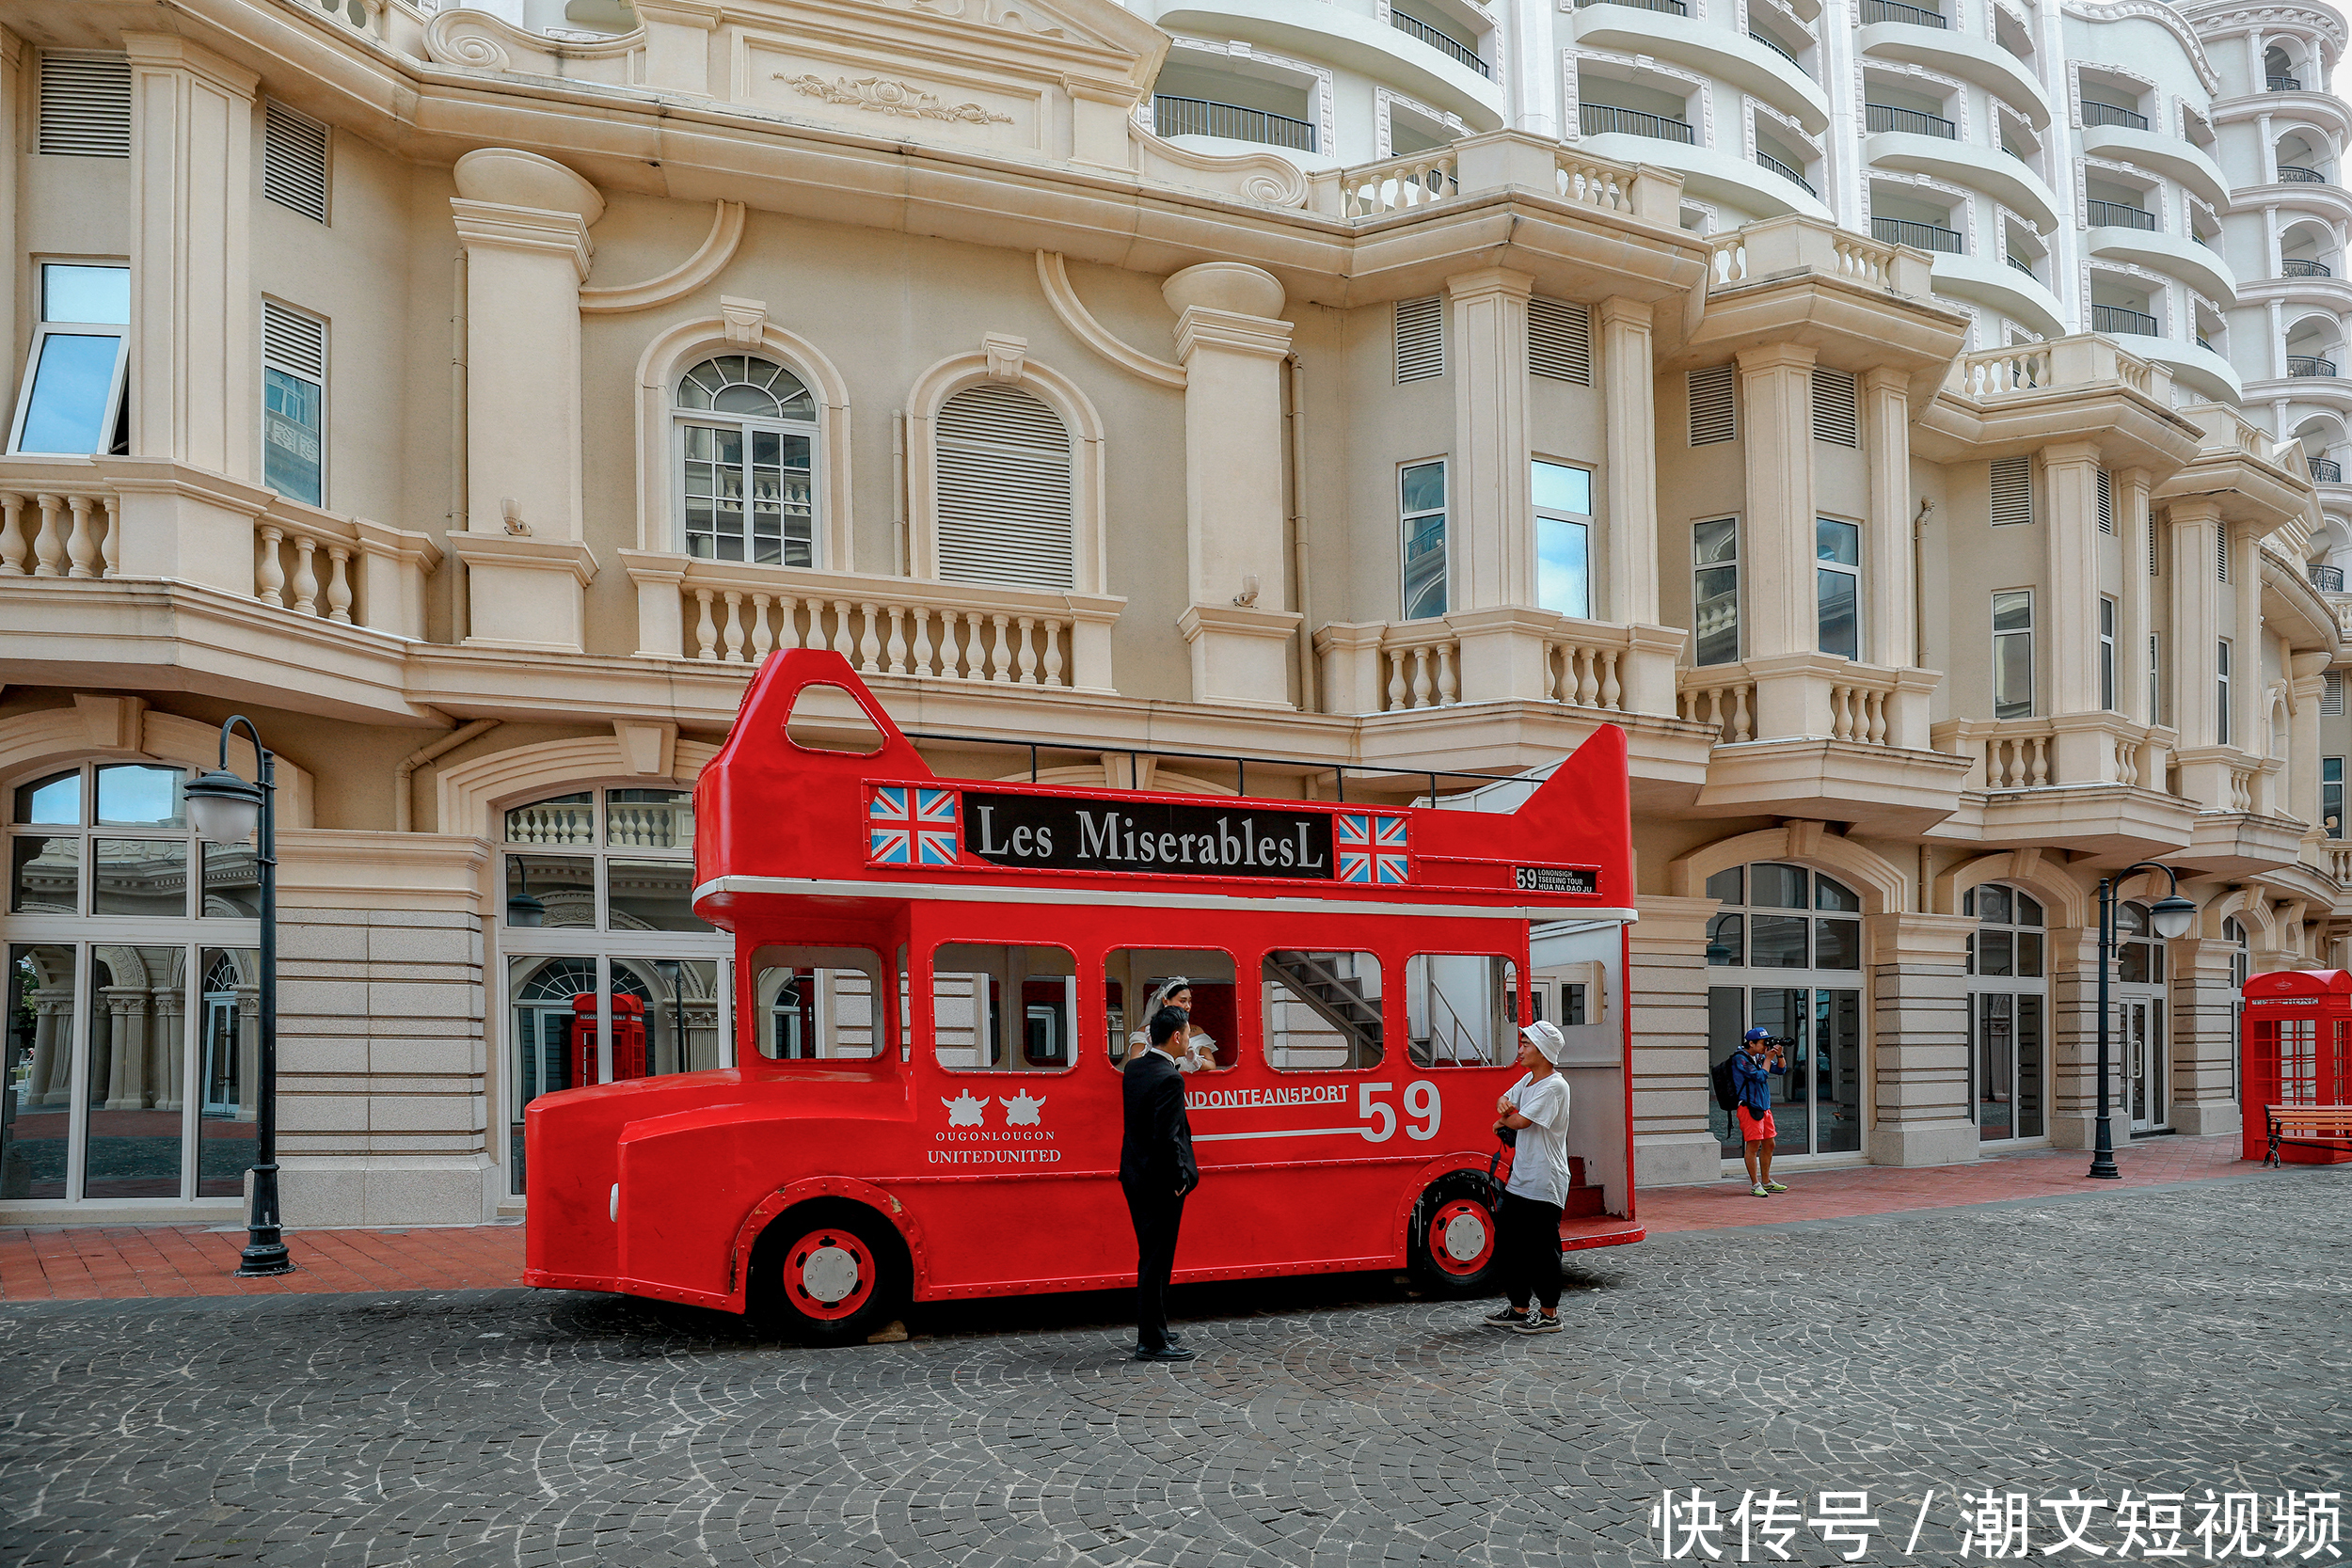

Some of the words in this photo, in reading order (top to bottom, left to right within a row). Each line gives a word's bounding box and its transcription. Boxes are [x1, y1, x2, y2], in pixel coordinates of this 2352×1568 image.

[977, 805, 1054, 859] Les
[1075, 810, 1325, 868] MiserablesL
[1516, 868, 1537, 890] 59
[1537, 868, 1573, 878] LONONSIGH
[1566, 878, 1583, 886] TOUR
[1566, 884, 1582, 893] DAO
[1359, 1079, 1442, 1144] 59
[935, 1131, 1056, 1142] OUGONLOUGON
[927, 1149, 1062, 1164] UNITEDUNITED
